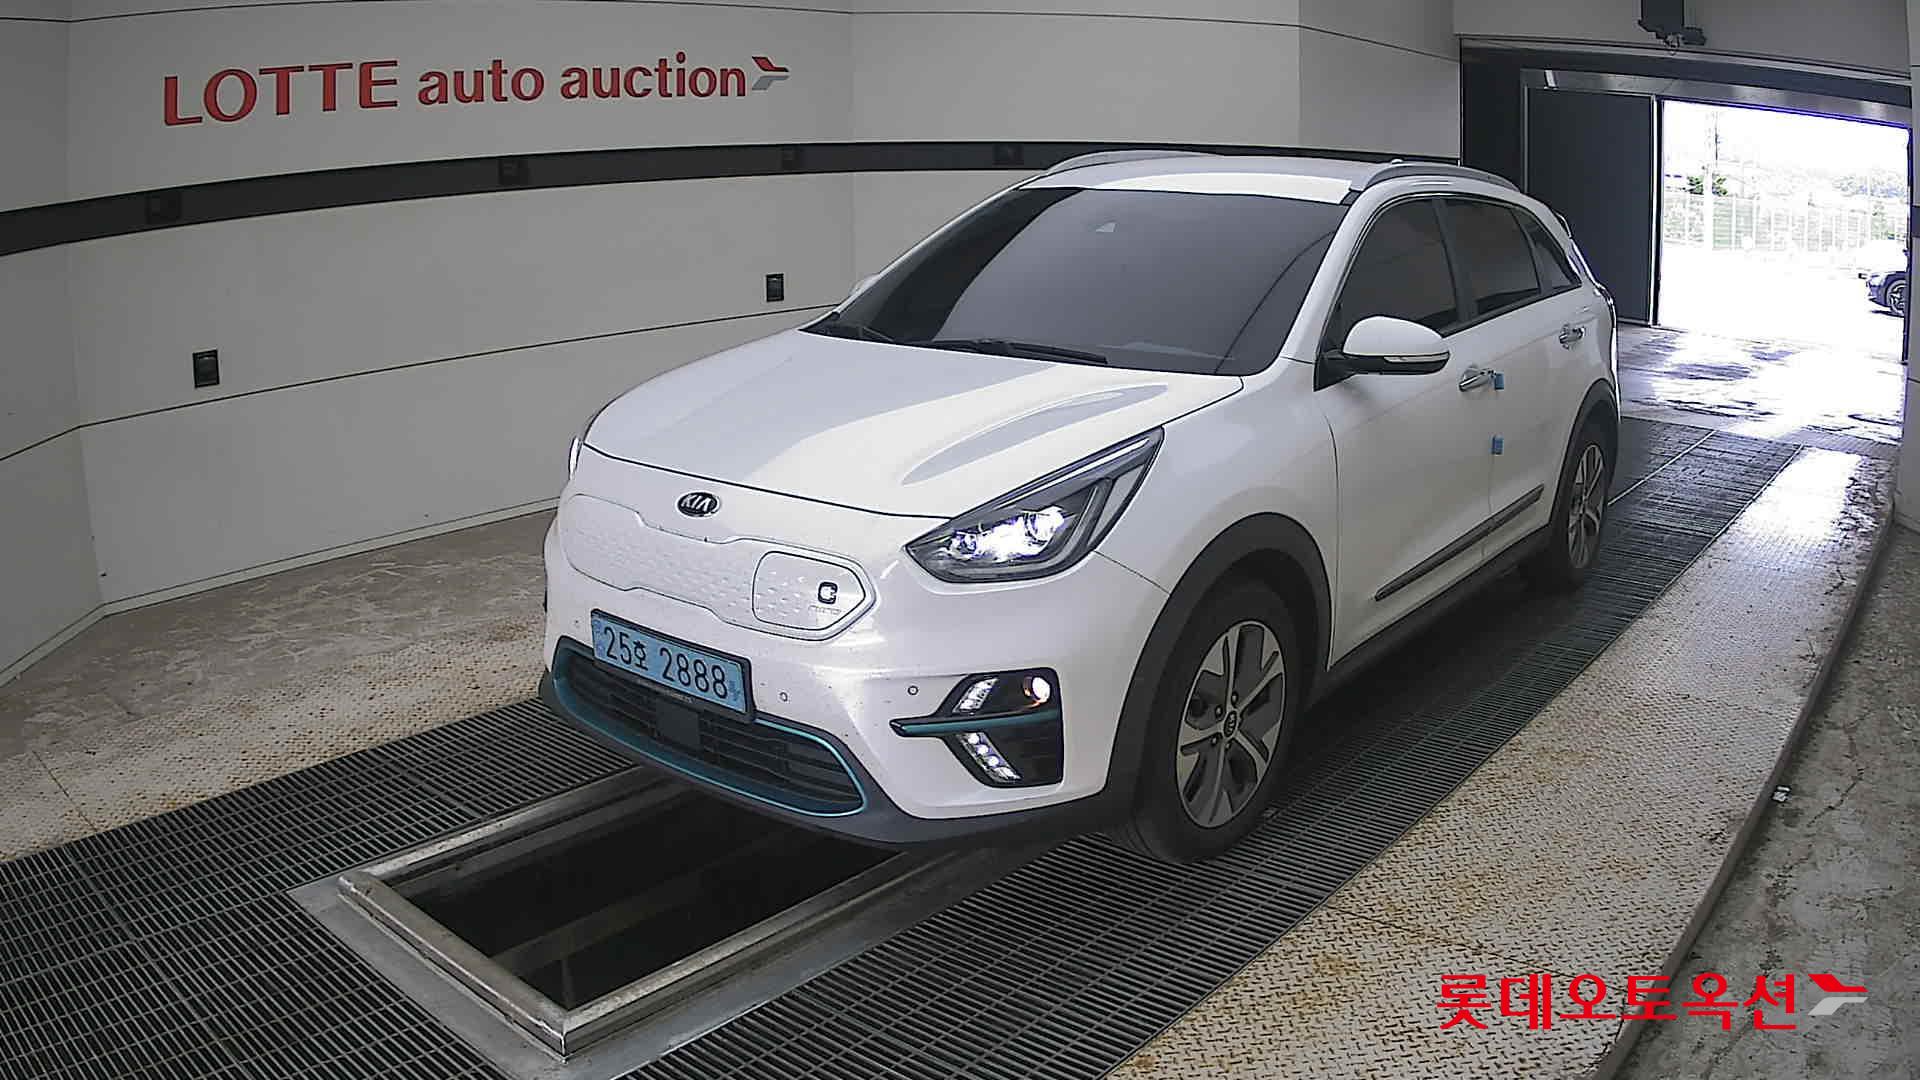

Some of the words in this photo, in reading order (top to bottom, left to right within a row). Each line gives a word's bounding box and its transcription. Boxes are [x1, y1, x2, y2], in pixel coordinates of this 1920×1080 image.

[164, 59, 399, 126] LOTTE
[417, 58, 545, 105] auto
[560, 50, 747, 99] auction
[604, 626, 649, 671] 25호
[659, 647, 728, 699] 2888
